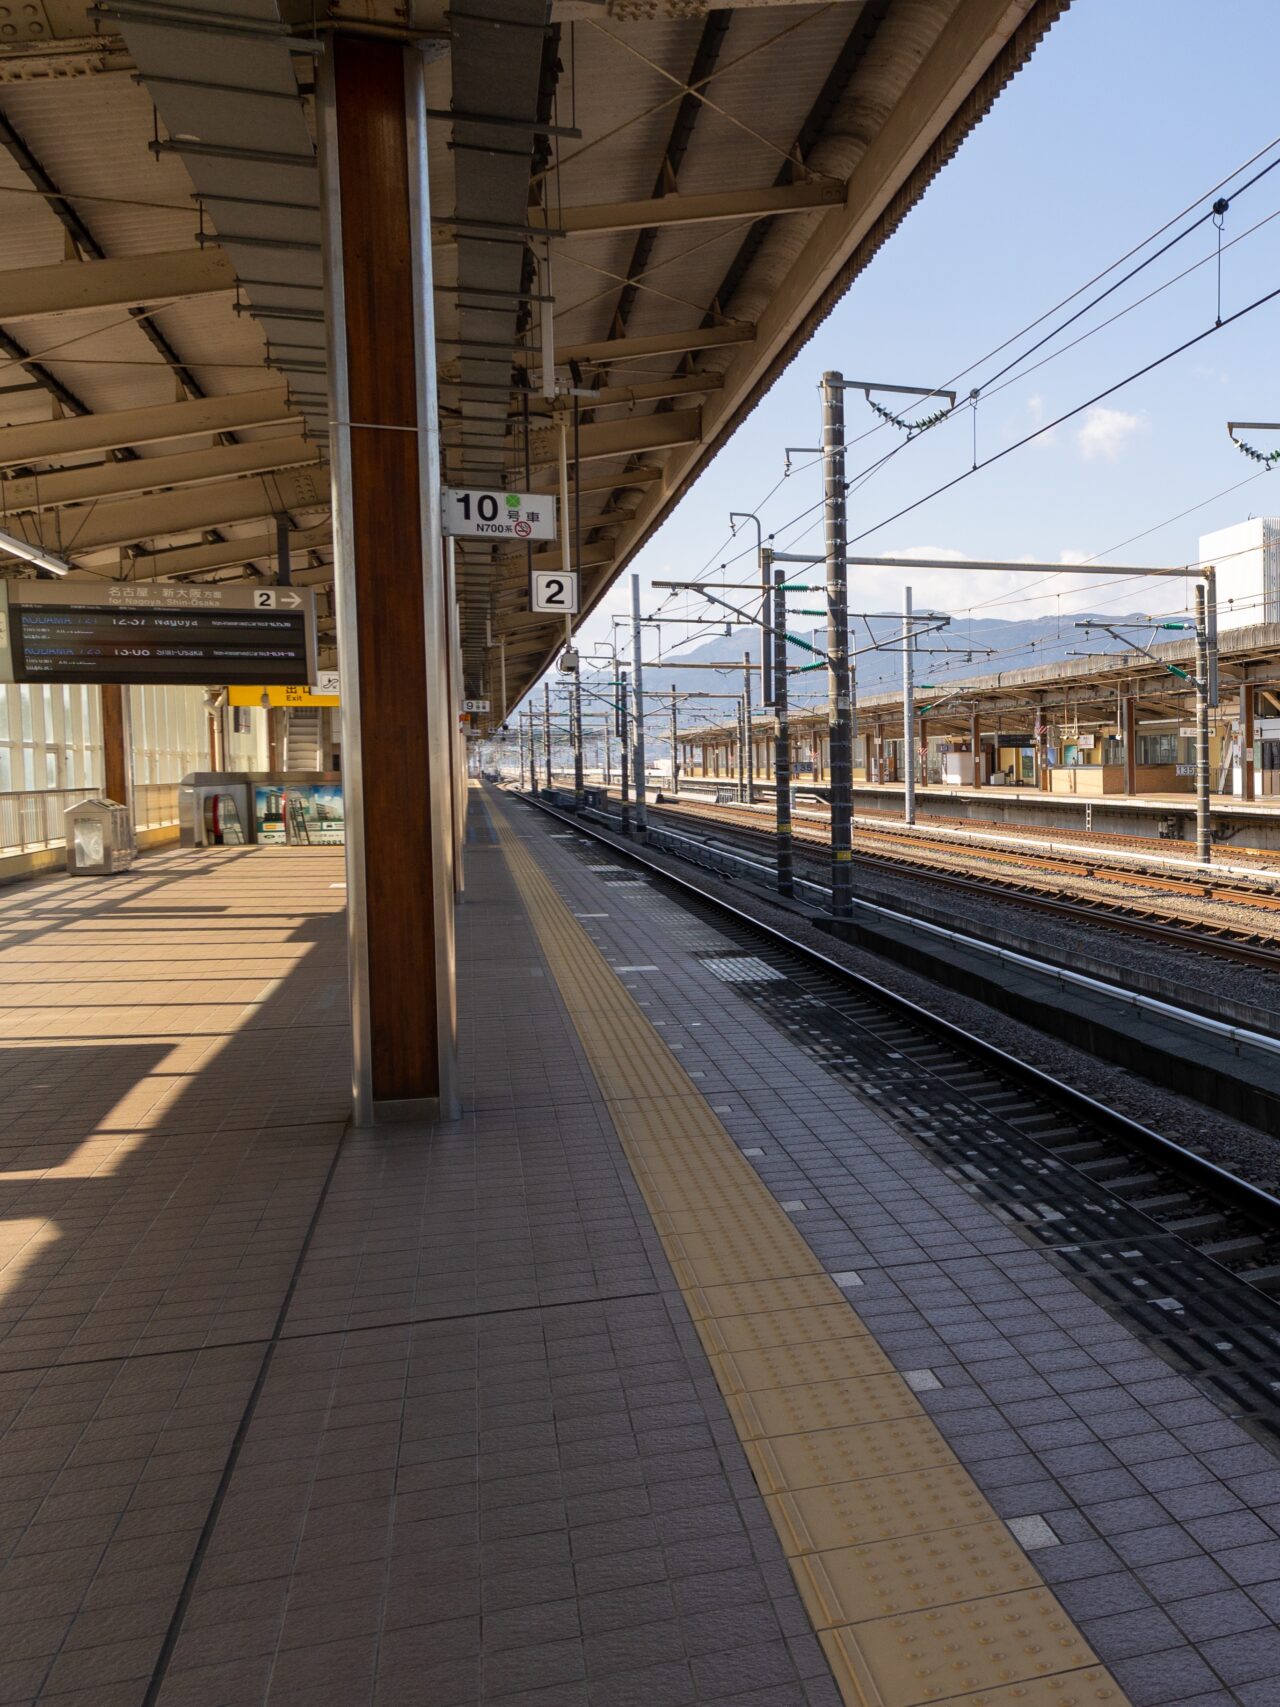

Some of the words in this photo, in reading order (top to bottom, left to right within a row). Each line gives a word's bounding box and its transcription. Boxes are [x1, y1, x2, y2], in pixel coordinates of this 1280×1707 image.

[456, 493, 499, 522] 10
[506, 510, 541, 523] 号車
[476, 523, 513, 534] N700系
[258, 592, 272, 607] 2
[545, 579, 565, 605] 2
[108, 597, 121, 605] for
